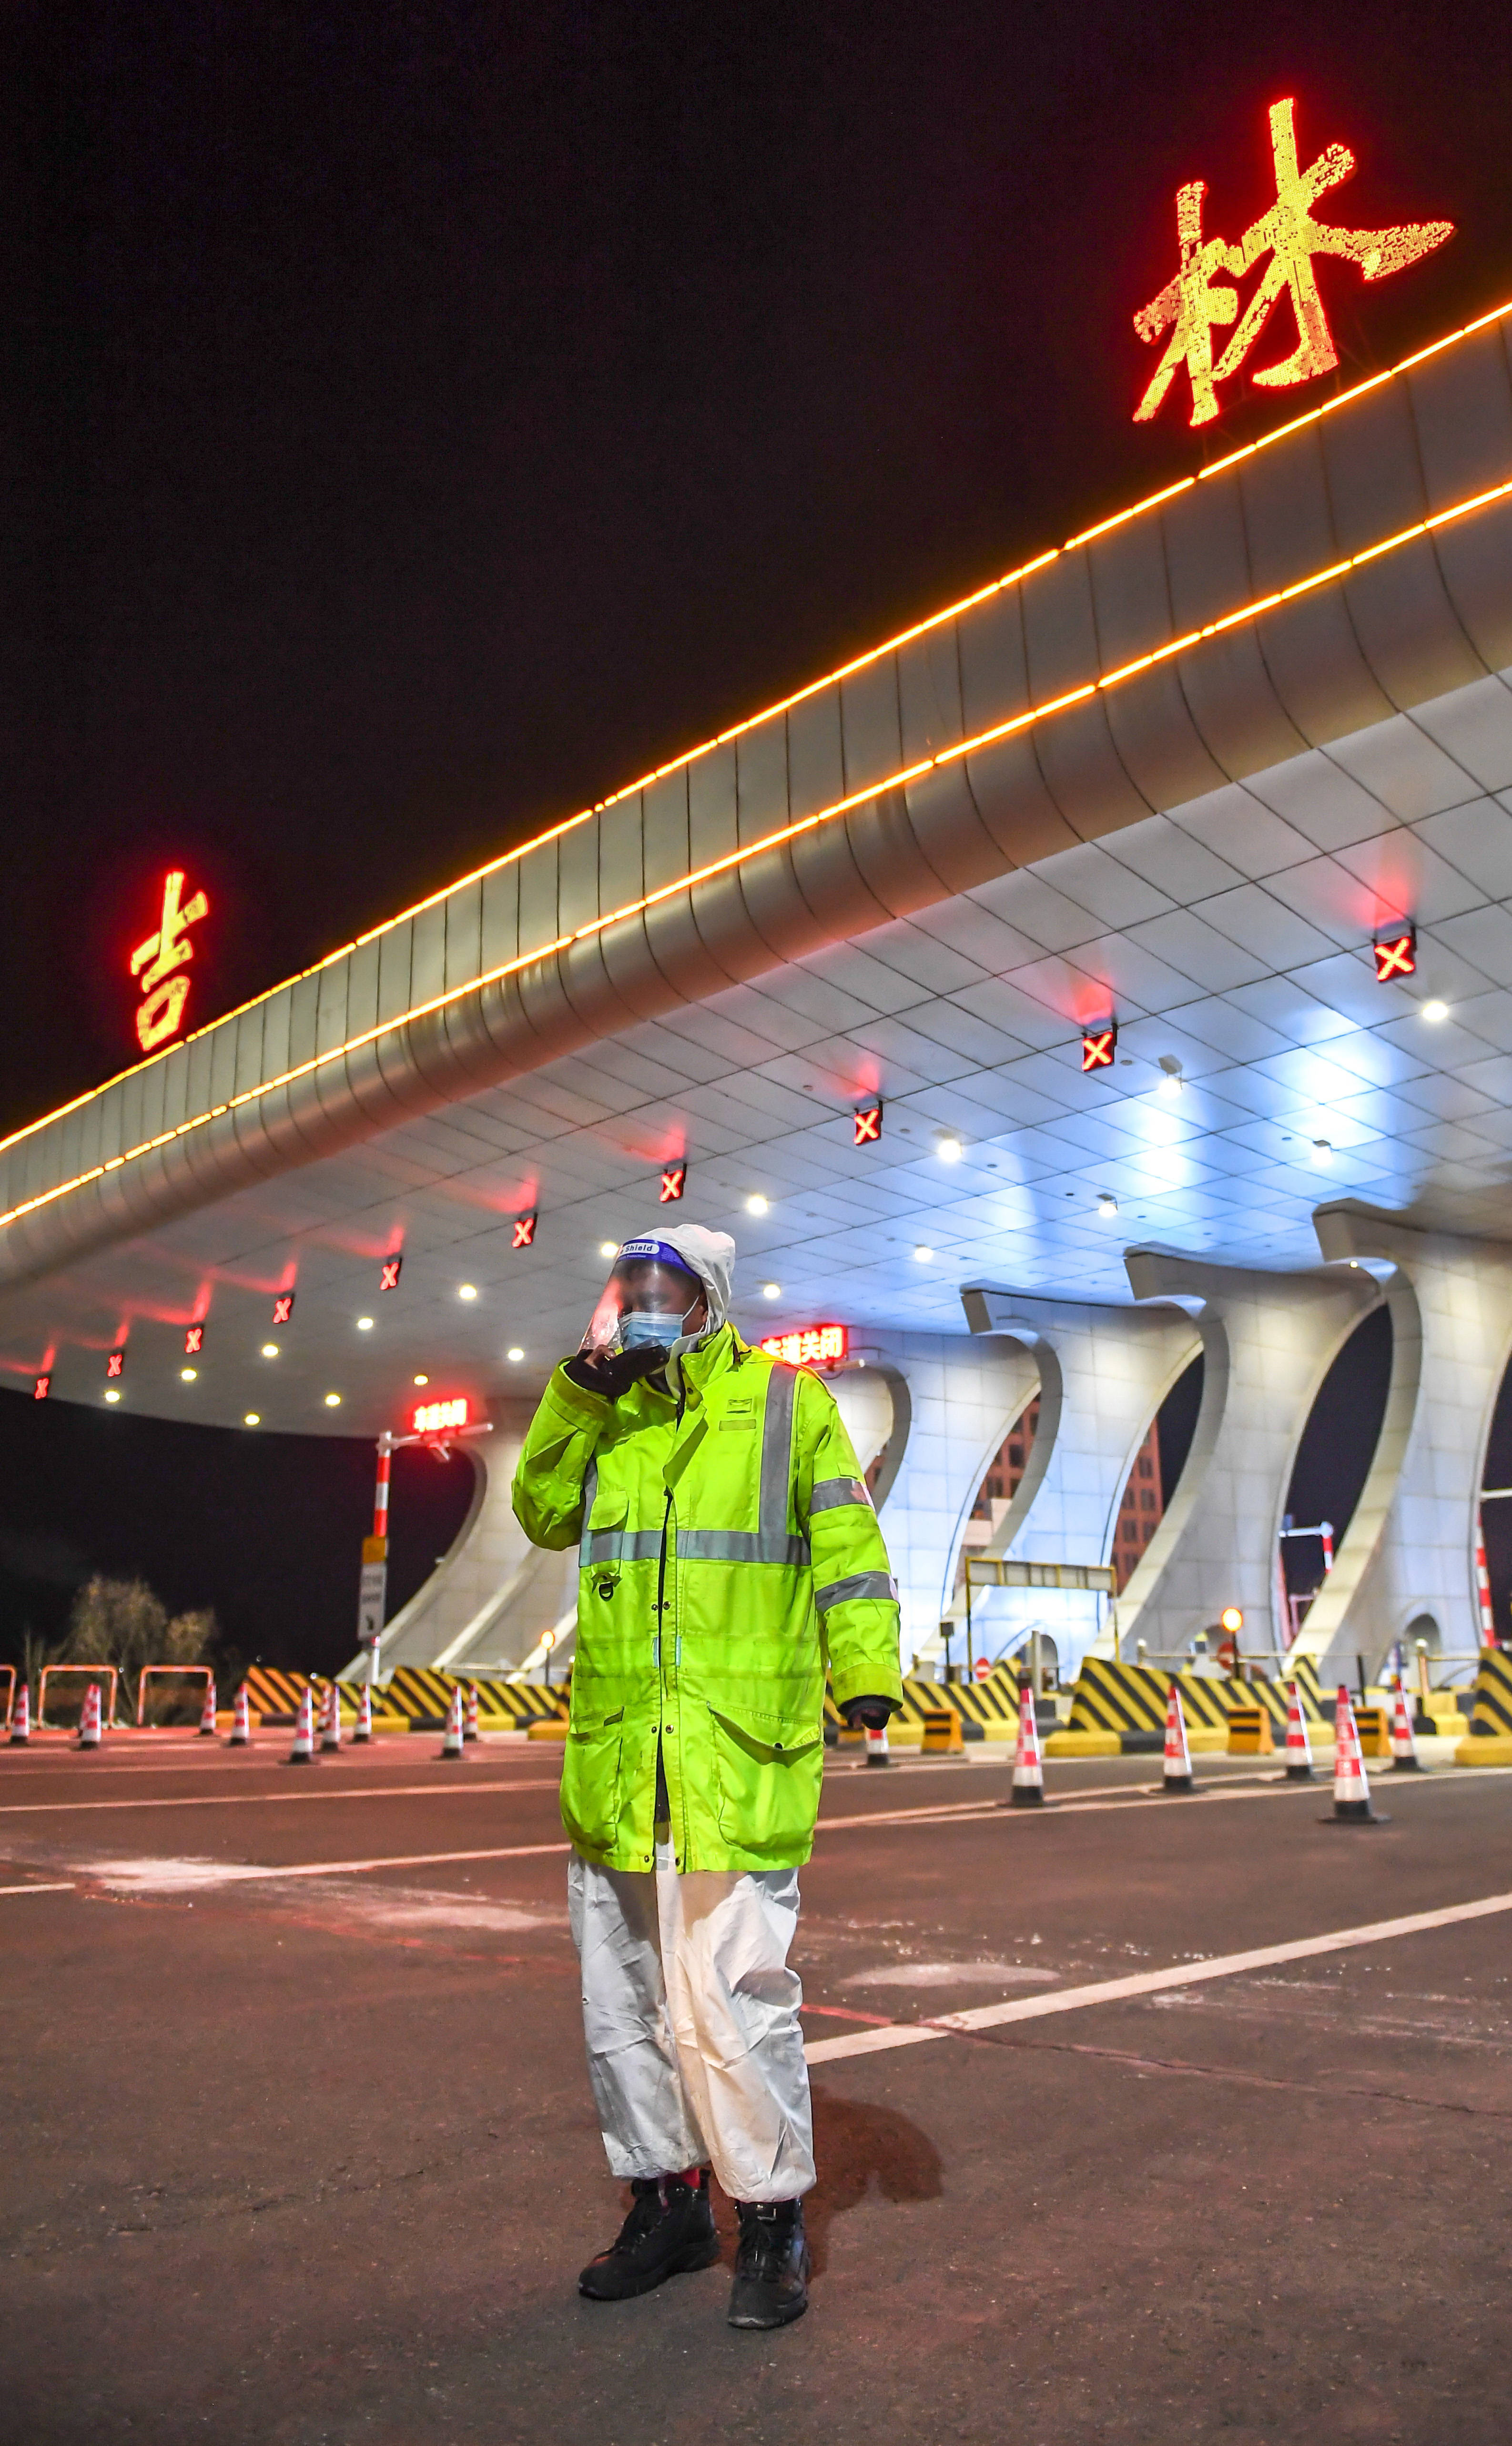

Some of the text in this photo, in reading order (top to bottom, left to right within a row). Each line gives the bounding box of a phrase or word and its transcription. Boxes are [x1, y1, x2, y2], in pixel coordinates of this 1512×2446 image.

[1133, 97, 1455, 427] 林
[131, 871, 208, 1051] 吉
[625, 1244, 653, 1252] Shield
